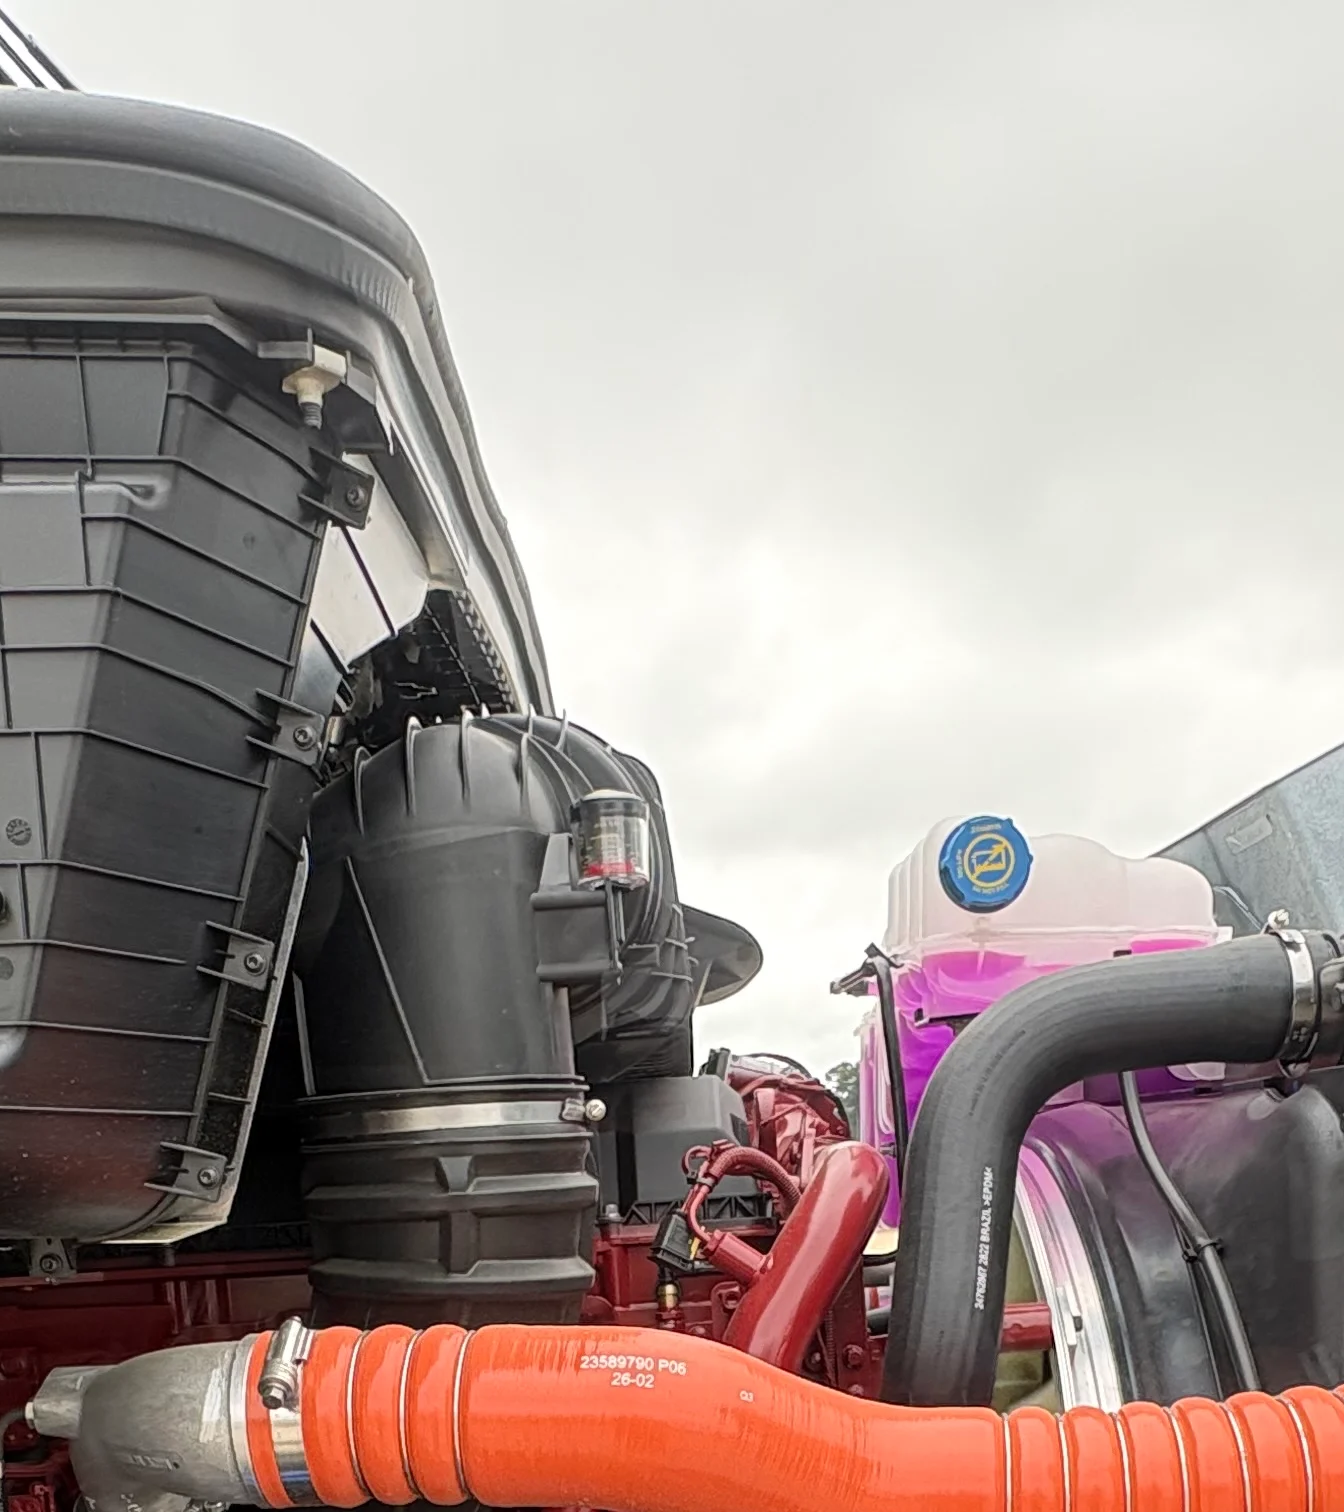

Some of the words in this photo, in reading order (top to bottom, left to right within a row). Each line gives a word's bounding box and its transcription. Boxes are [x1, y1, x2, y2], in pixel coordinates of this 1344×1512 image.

[980, 1207, 992, 1243] BRAZIL
[580, 1355, 655, 1371] 23589790
[658, 1359, 688, 1376] P06
[610, 1372, 655, 1389] 26-02
